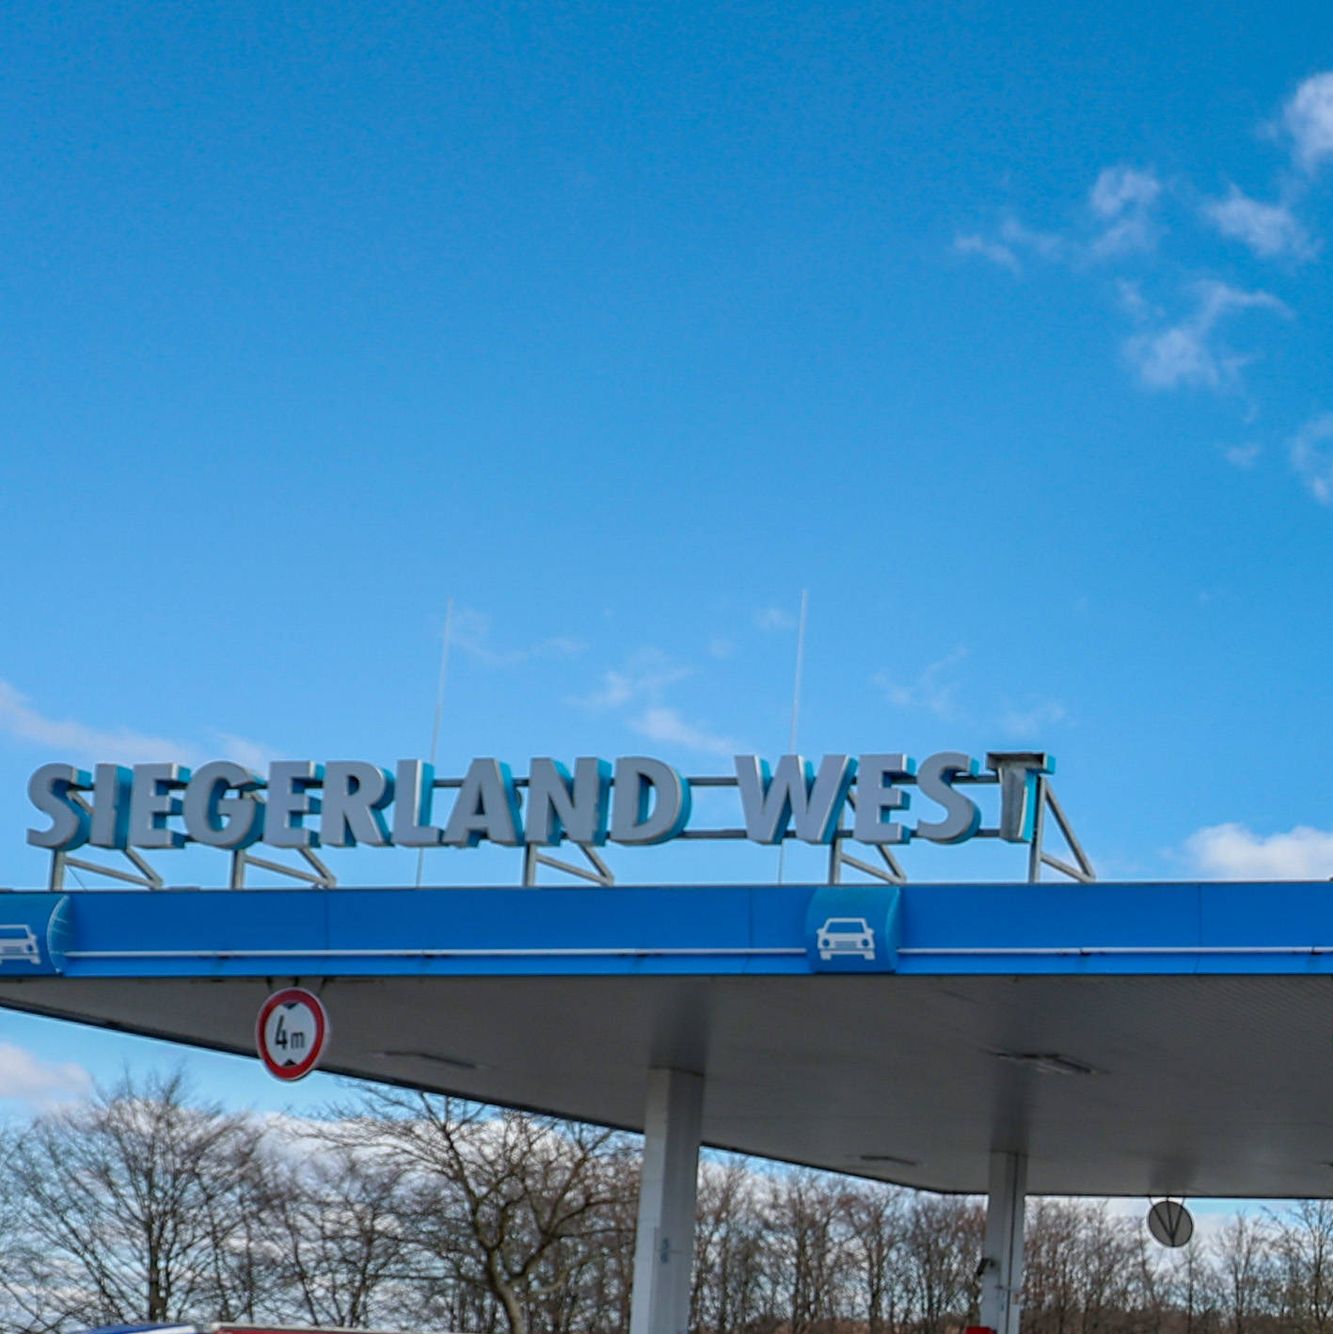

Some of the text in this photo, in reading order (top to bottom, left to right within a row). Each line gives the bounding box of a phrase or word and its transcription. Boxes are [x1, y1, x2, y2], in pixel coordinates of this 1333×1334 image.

[26, 750, 1056, 851] SIEGERLAND WEST
[275, 1014, 305, 1050] 4 m
